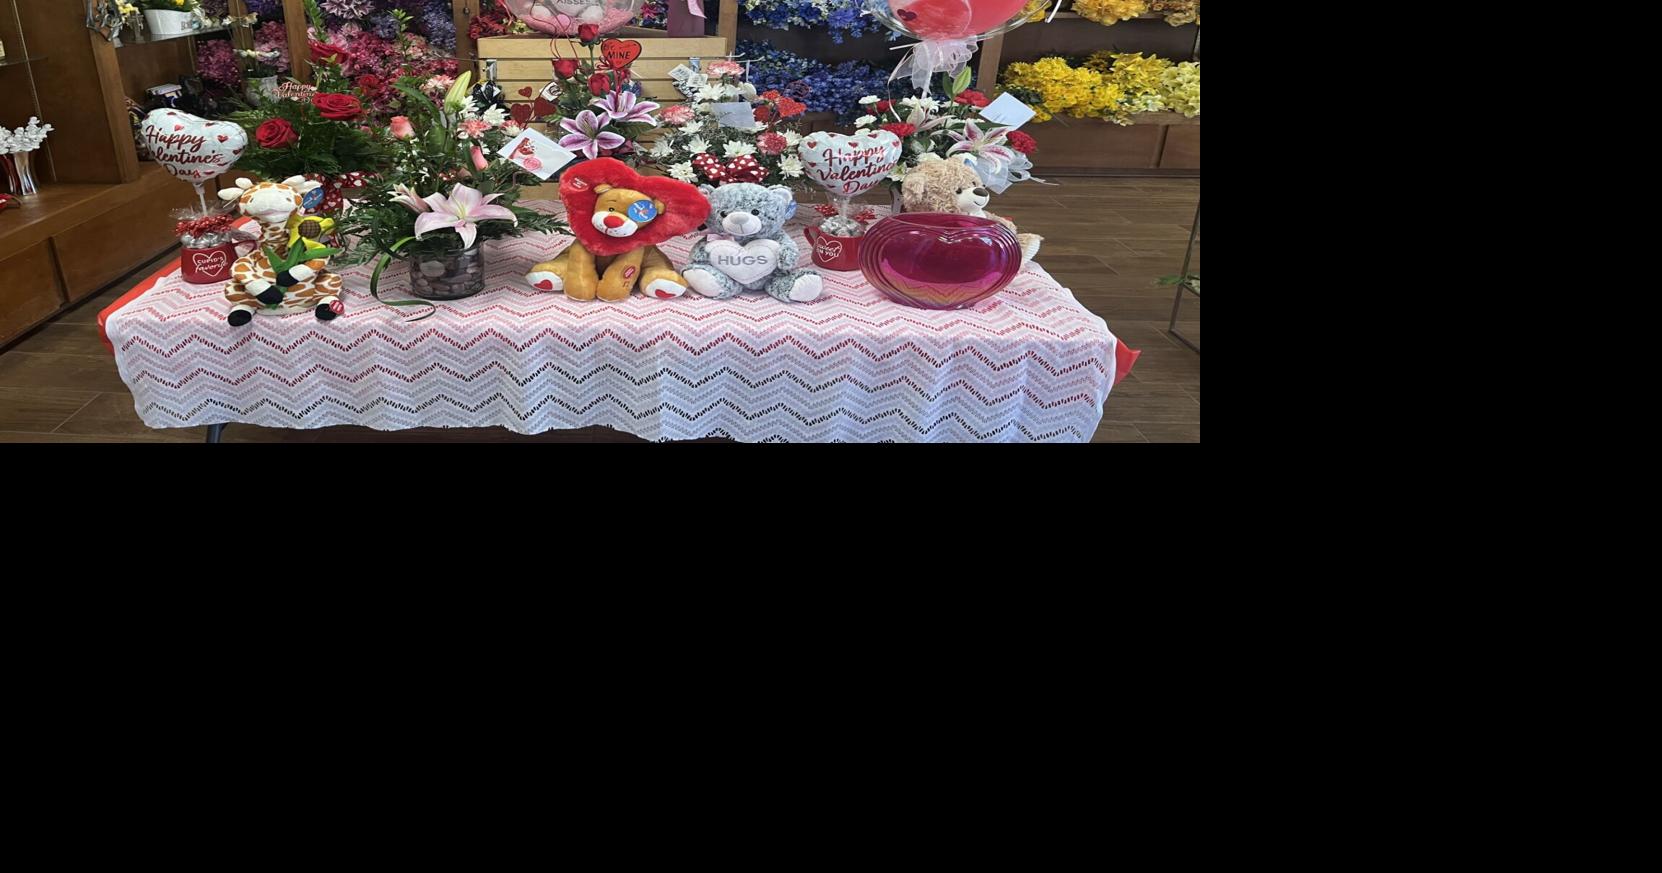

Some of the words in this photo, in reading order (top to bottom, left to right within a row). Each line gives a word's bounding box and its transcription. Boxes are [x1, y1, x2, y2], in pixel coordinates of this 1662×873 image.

[607, 51, 631, 60] MINE
[145, 124, 207, 153] Happy
[822, 145, 886, 167] Happy
[163, 163, 201, 179] Day
[717, 255, 768, 266] HUGS
[825, 250, 840, 258] YOU
